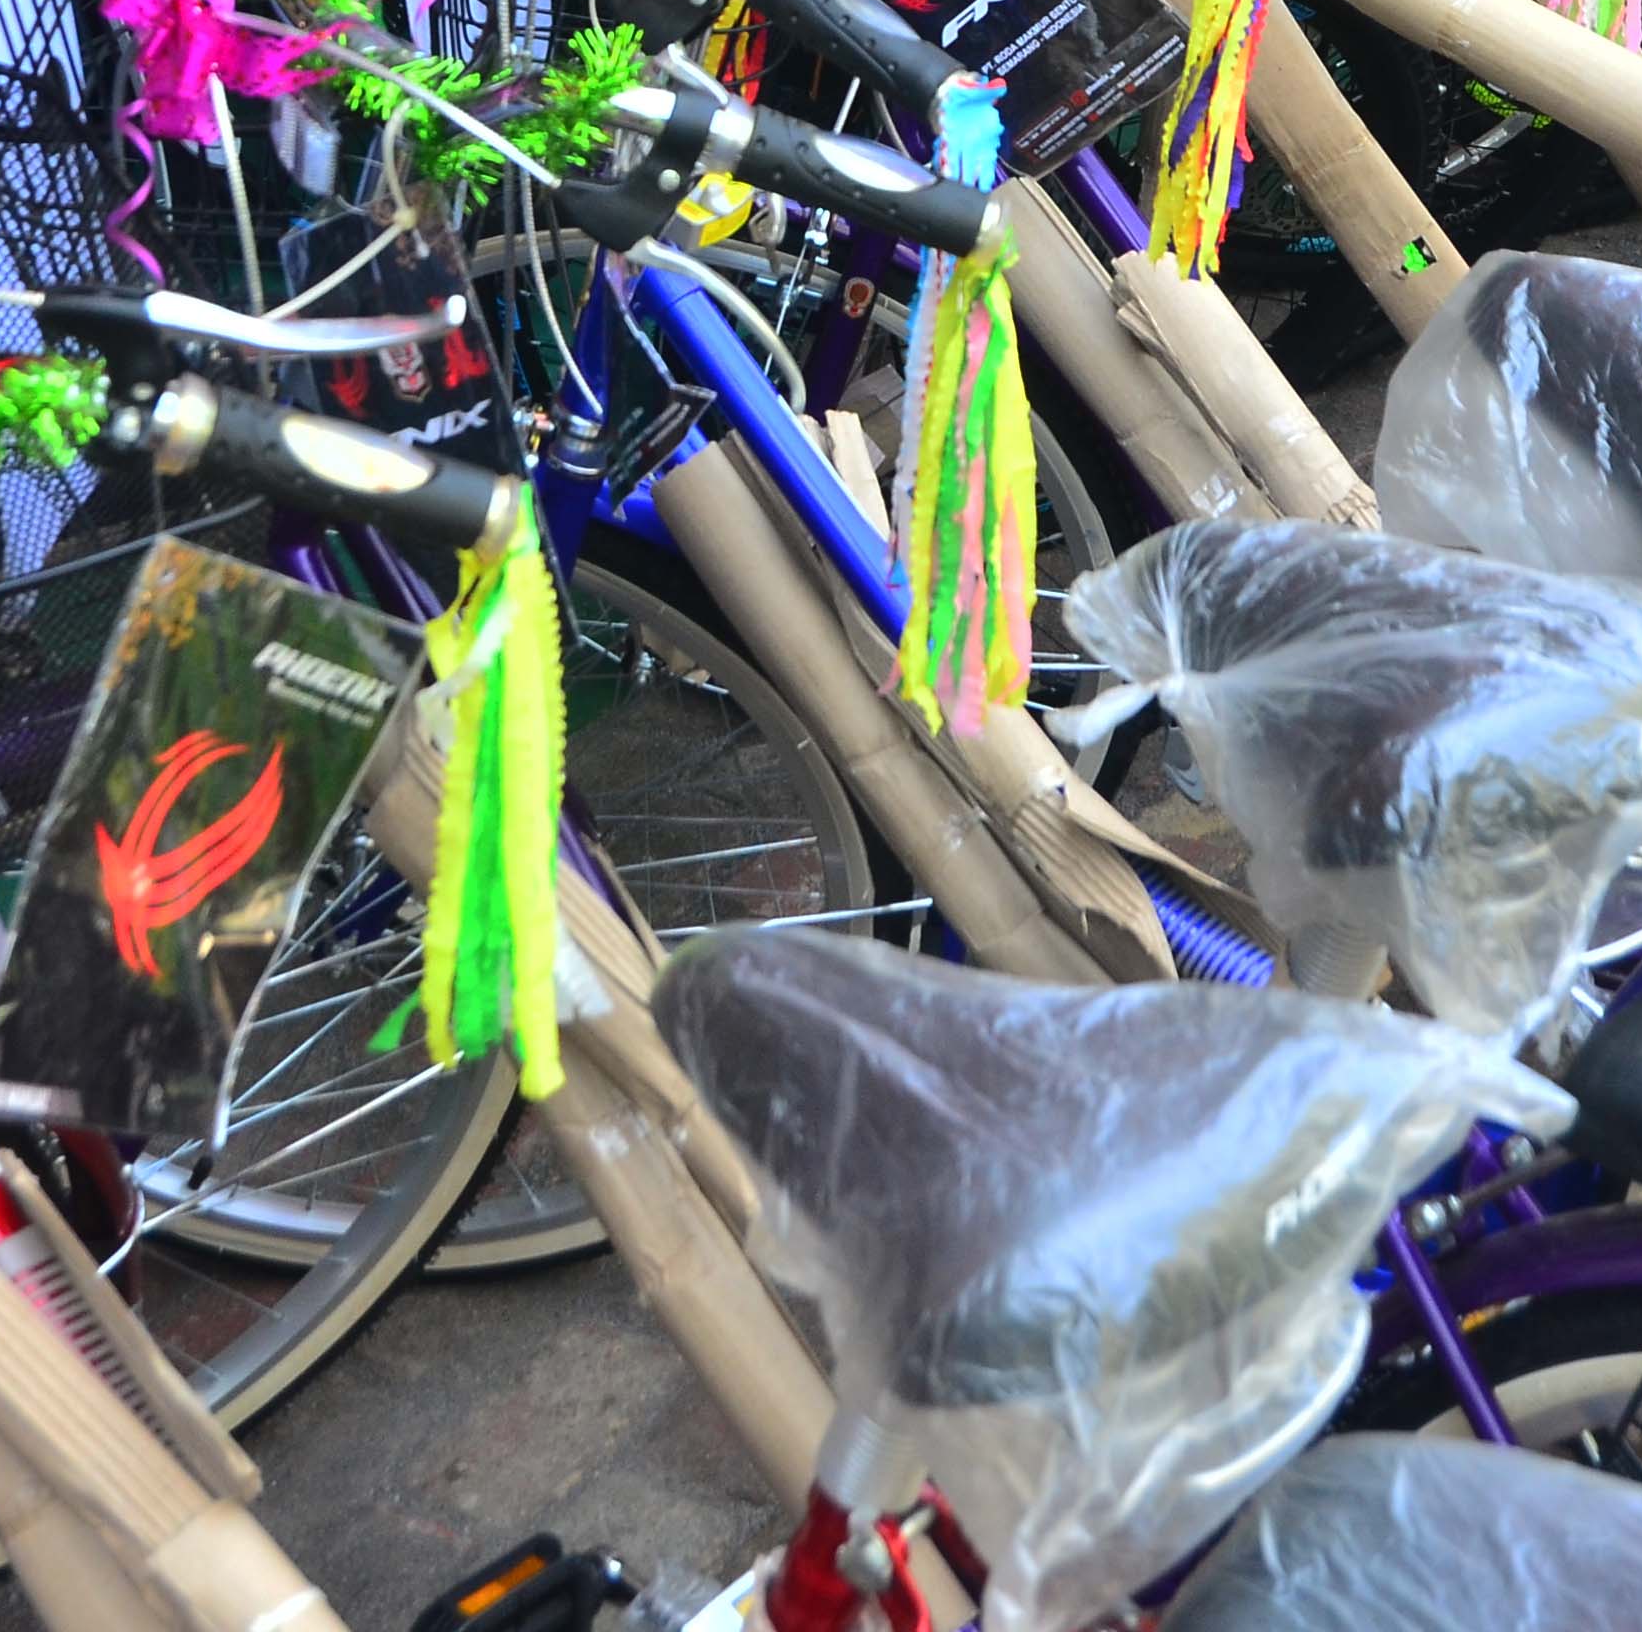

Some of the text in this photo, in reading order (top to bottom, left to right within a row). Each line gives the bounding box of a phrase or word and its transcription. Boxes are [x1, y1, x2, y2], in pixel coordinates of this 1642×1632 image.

[994, 43, 1018, 68] RODA
[997, 37, 1041, 76] SEMARANG
[1043, 2, 1087, 41] INDONESIA
[388, 398, 493, 449] NIX
[252, 640, 398, 712] PHOENIX
